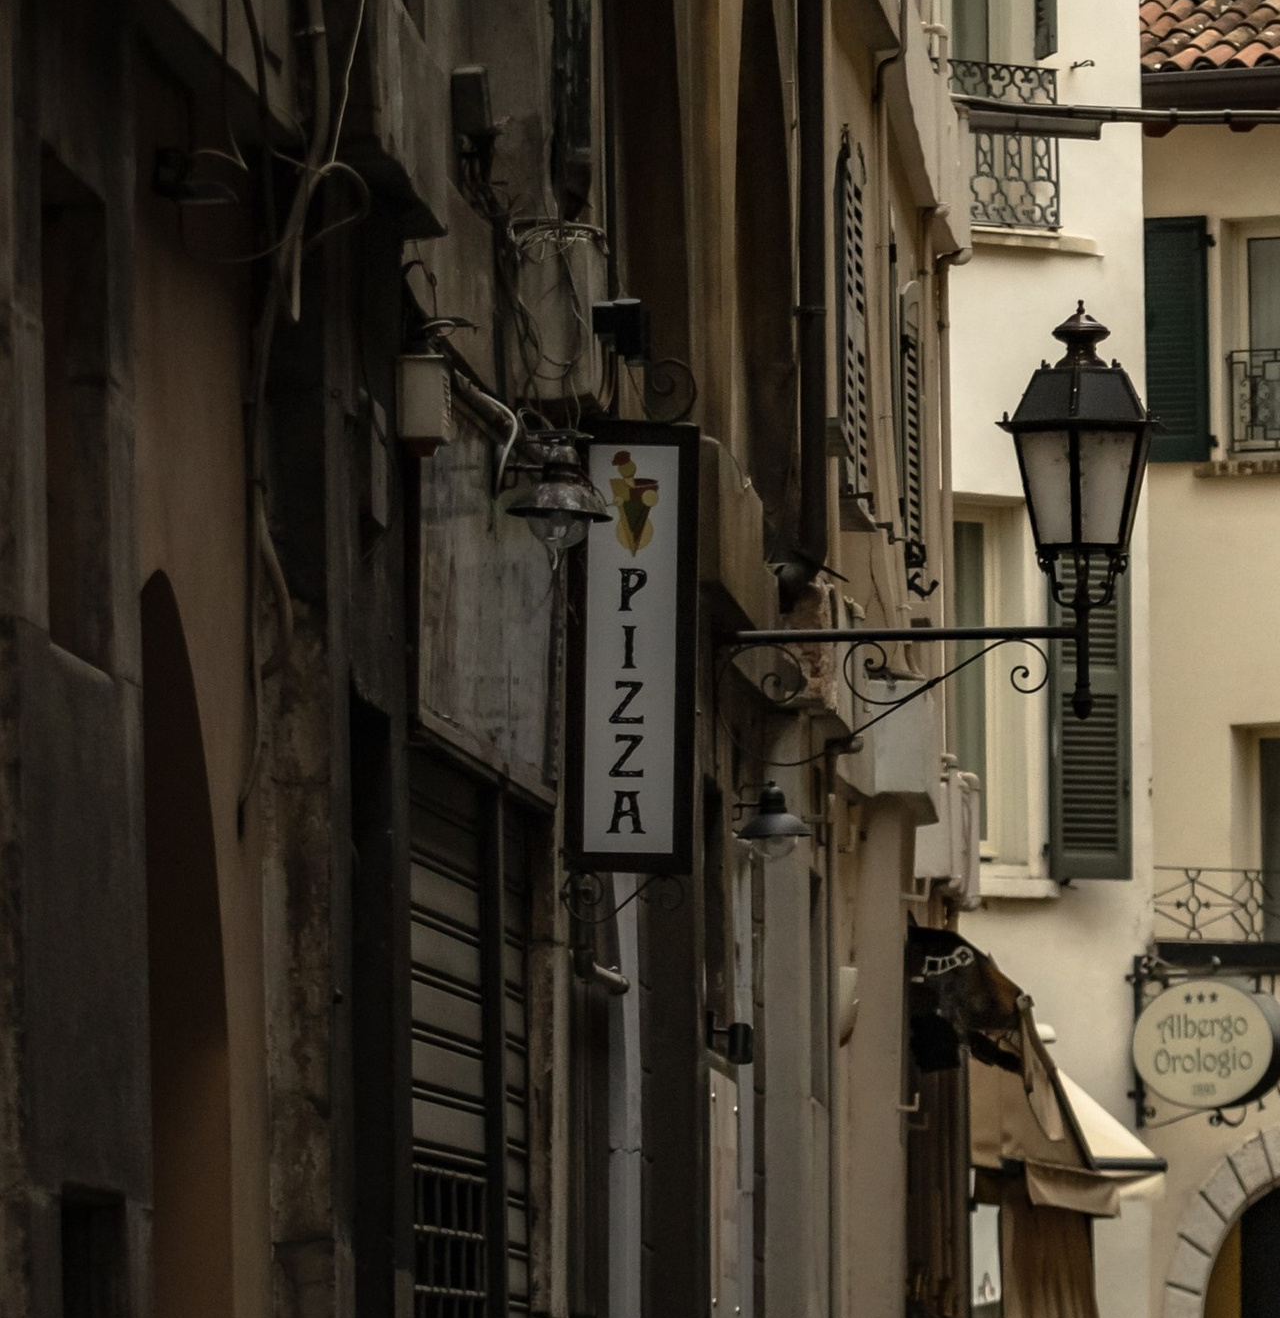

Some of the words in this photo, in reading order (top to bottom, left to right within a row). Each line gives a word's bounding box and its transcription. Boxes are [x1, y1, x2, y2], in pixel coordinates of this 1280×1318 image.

[606, 568, 648, 834] PIZZA
[1157, 1013, 1249, 1045] Albergo
[1154, 1047, 1253, 1079] Orologio
